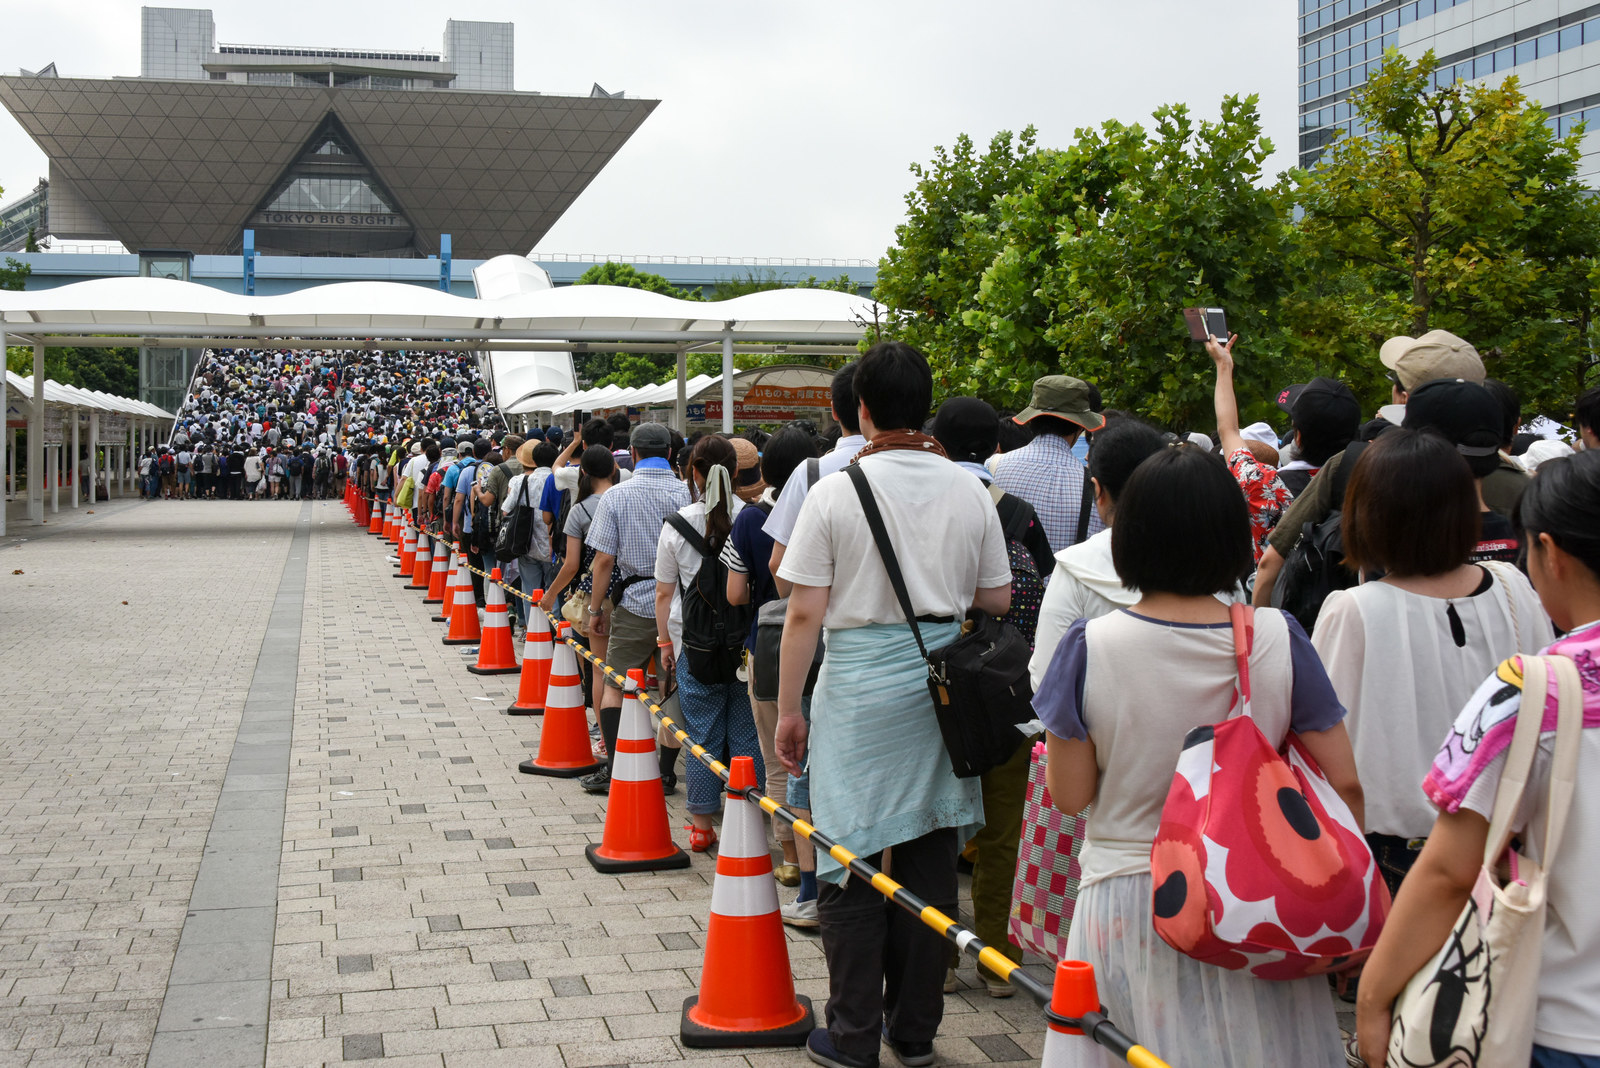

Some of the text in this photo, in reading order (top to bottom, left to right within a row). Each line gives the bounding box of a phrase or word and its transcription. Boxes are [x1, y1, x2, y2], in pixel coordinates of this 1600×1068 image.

[263, 213, 397, 225] TOKYO BIG SIGHT
